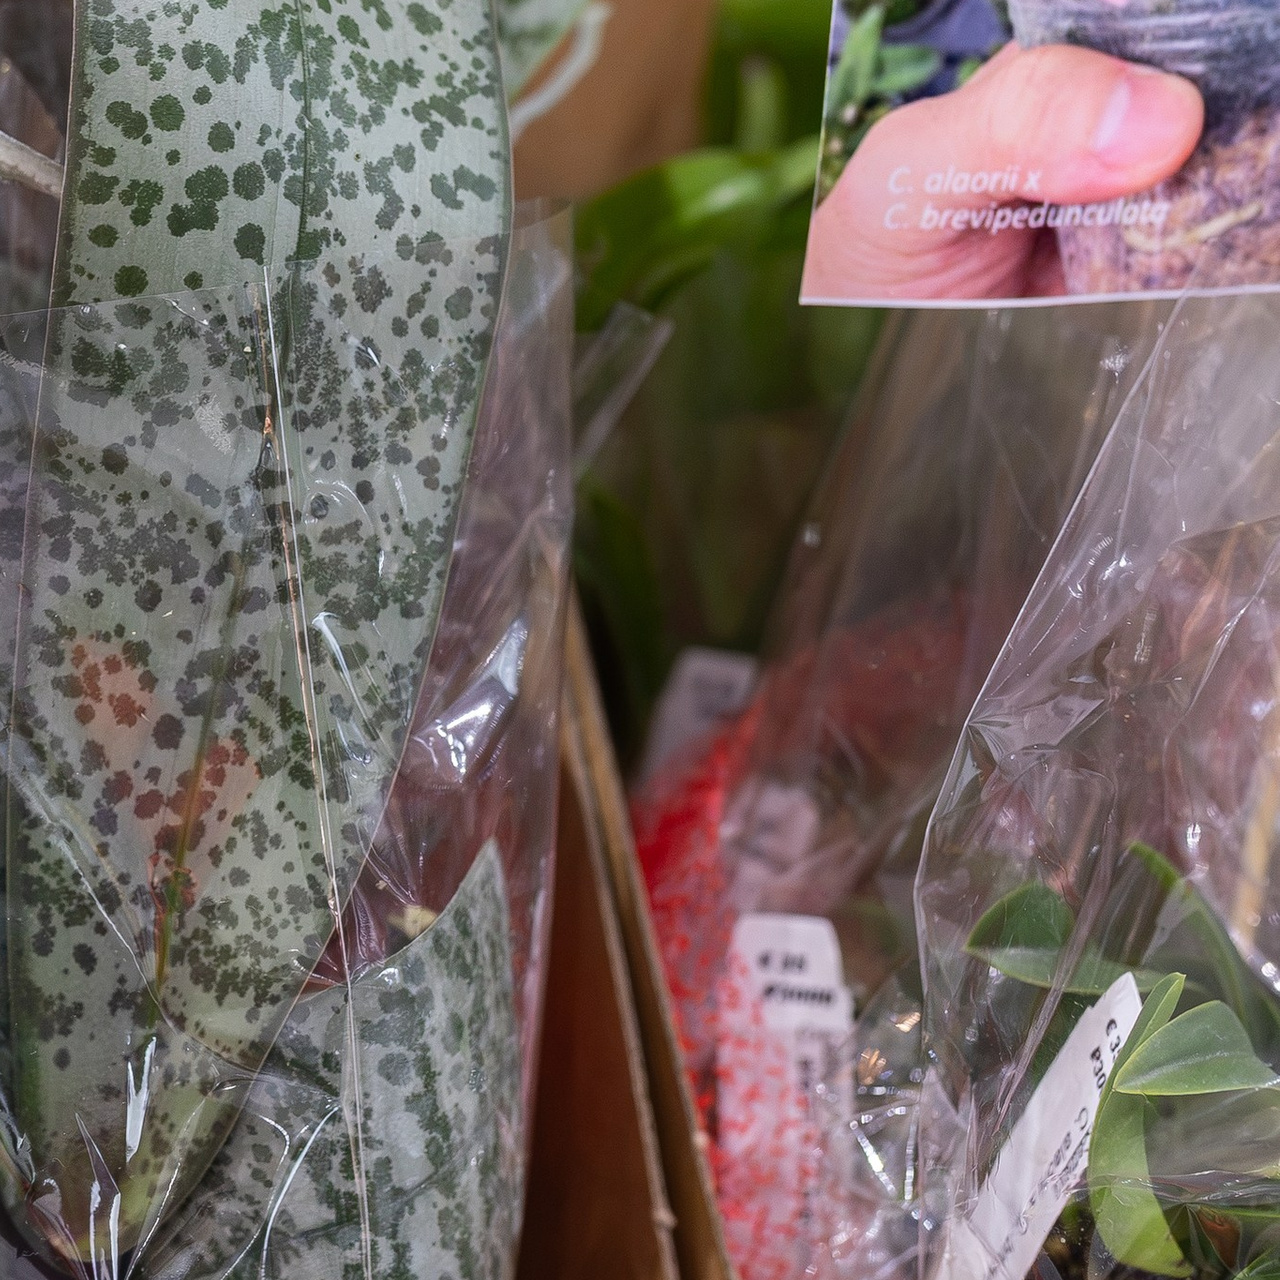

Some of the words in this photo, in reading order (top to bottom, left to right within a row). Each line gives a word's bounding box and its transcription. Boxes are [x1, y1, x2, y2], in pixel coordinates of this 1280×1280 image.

[887, 166, 916, 195] C.
[923, 165, 1020, 194] alaorii
[1022, 172, 1043, 192] x
[883, 203, 914, 231] C.
[919, 199, 1171, 235] brevipedunculata
